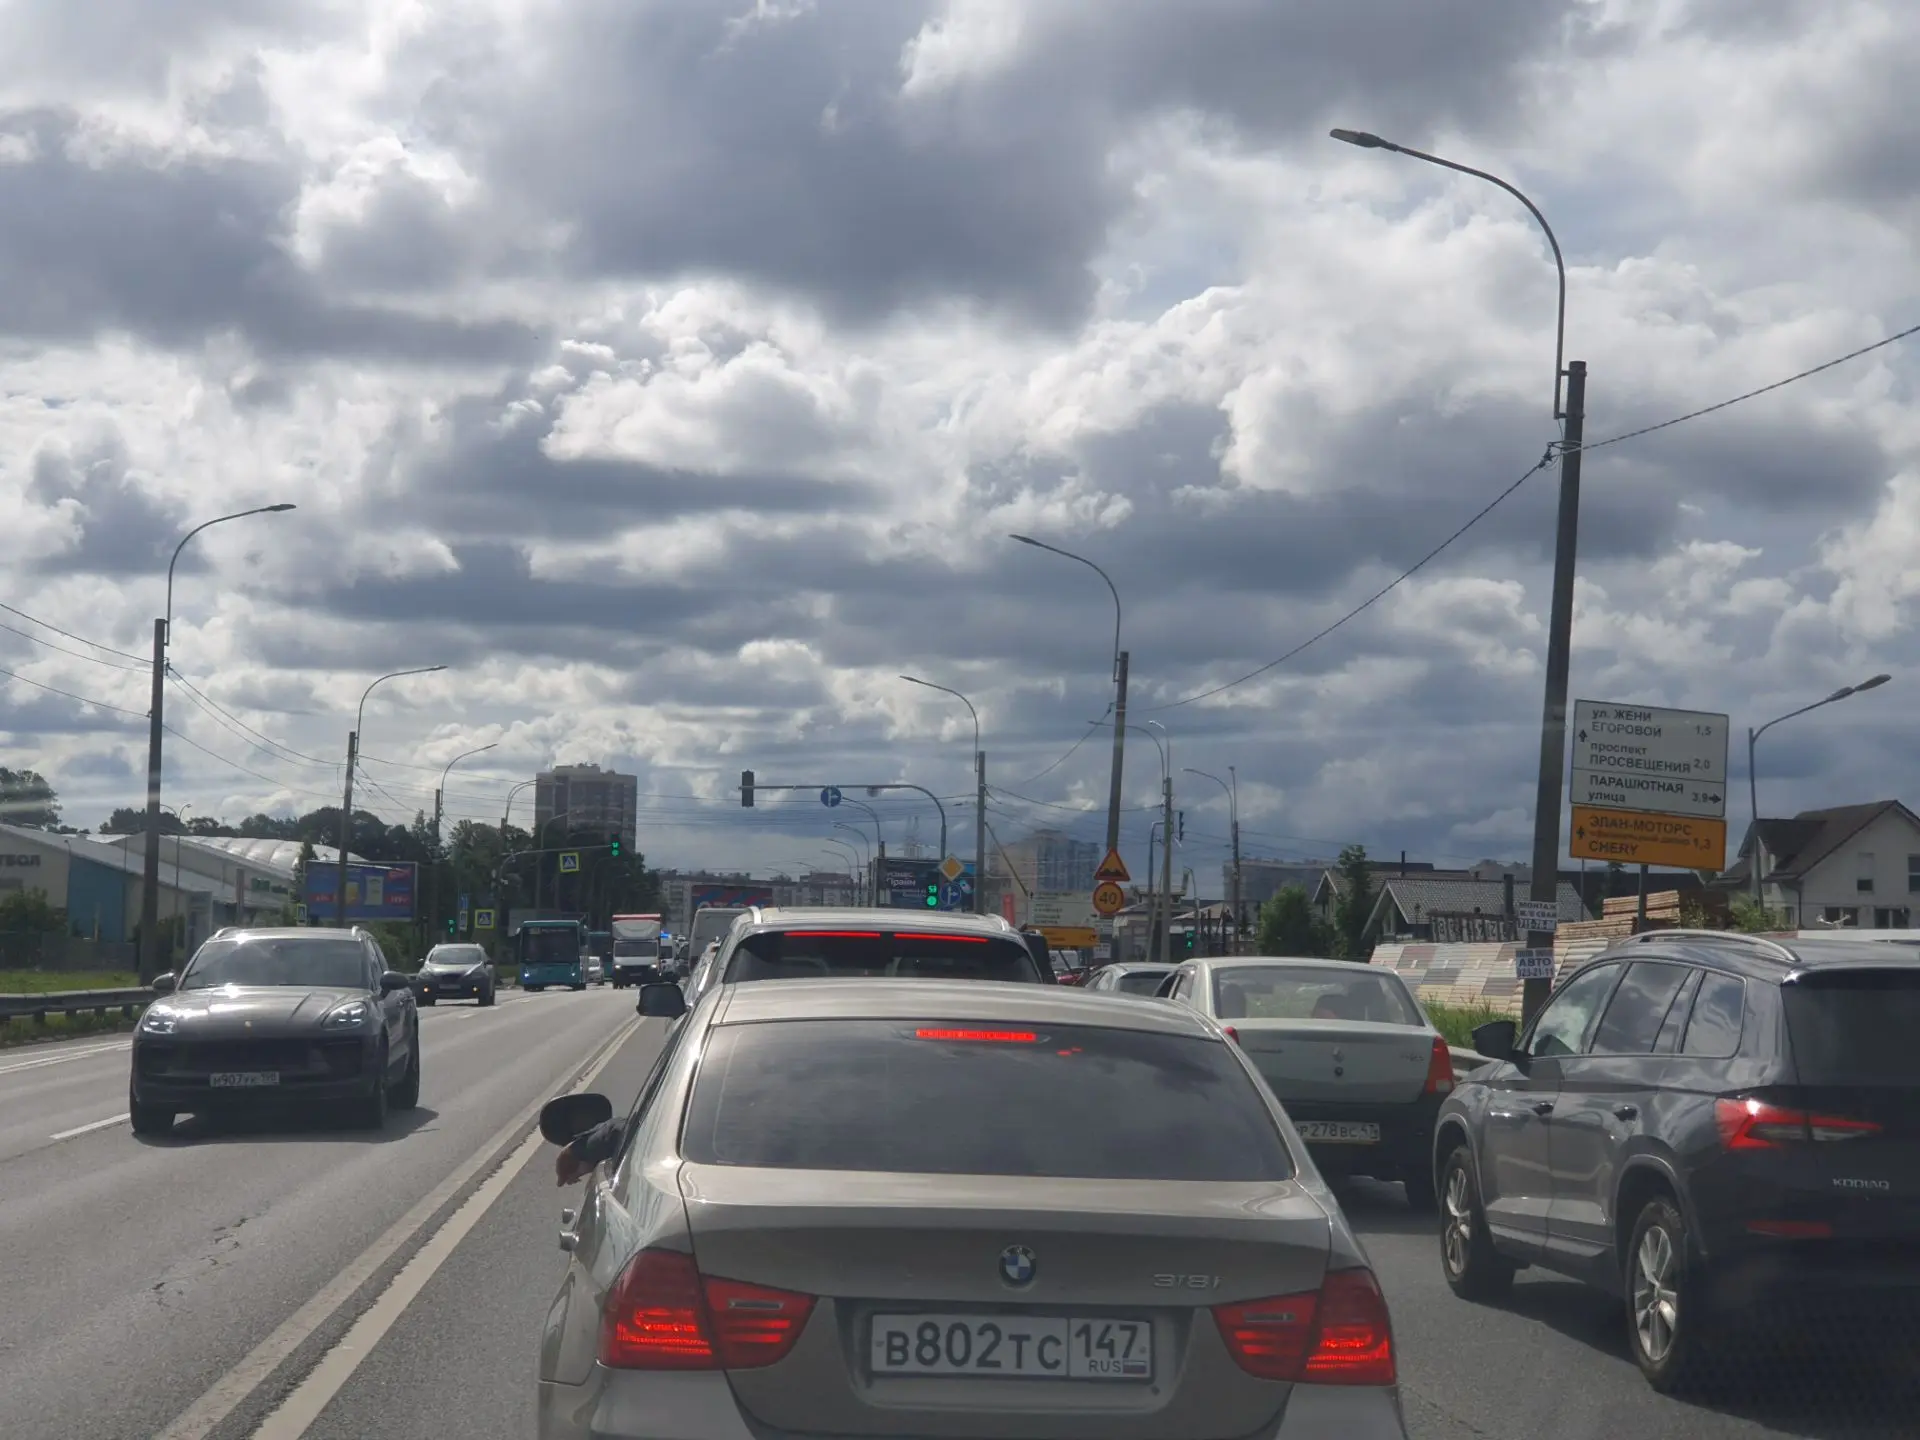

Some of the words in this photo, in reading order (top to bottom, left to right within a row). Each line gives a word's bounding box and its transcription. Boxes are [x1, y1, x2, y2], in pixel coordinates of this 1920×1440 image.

[1592, 709, 1611, 720] ул.
[1614, 708, 1652, 722] ЖЕНИ
[1591, 721, 1662, 738] ЕГОРОВОЙ
[1695, 725, 1712, 736] 1,5
[1590, 742, 1648, 755] проспект
[1590, 754, 1691, 773] ПРОСВЕЩЕНИЯ
[1693, 758, 1711, 770] 2,0
[1590, 774, 1684, 794] ПАРАШЮТНАЯ
[1588, 790, 1626, 803] улица
[1588, 839, 1639, 855] CHERY
[1099, 891, 1117, 905] 40
[1519, 957, 1551, 967] АВТО
[1832, 1177, 1890, 1191] KODIAQ
[1074, 1323, 1138, 1360] 147
[1088, 1360, 1122, 1374] RUS
